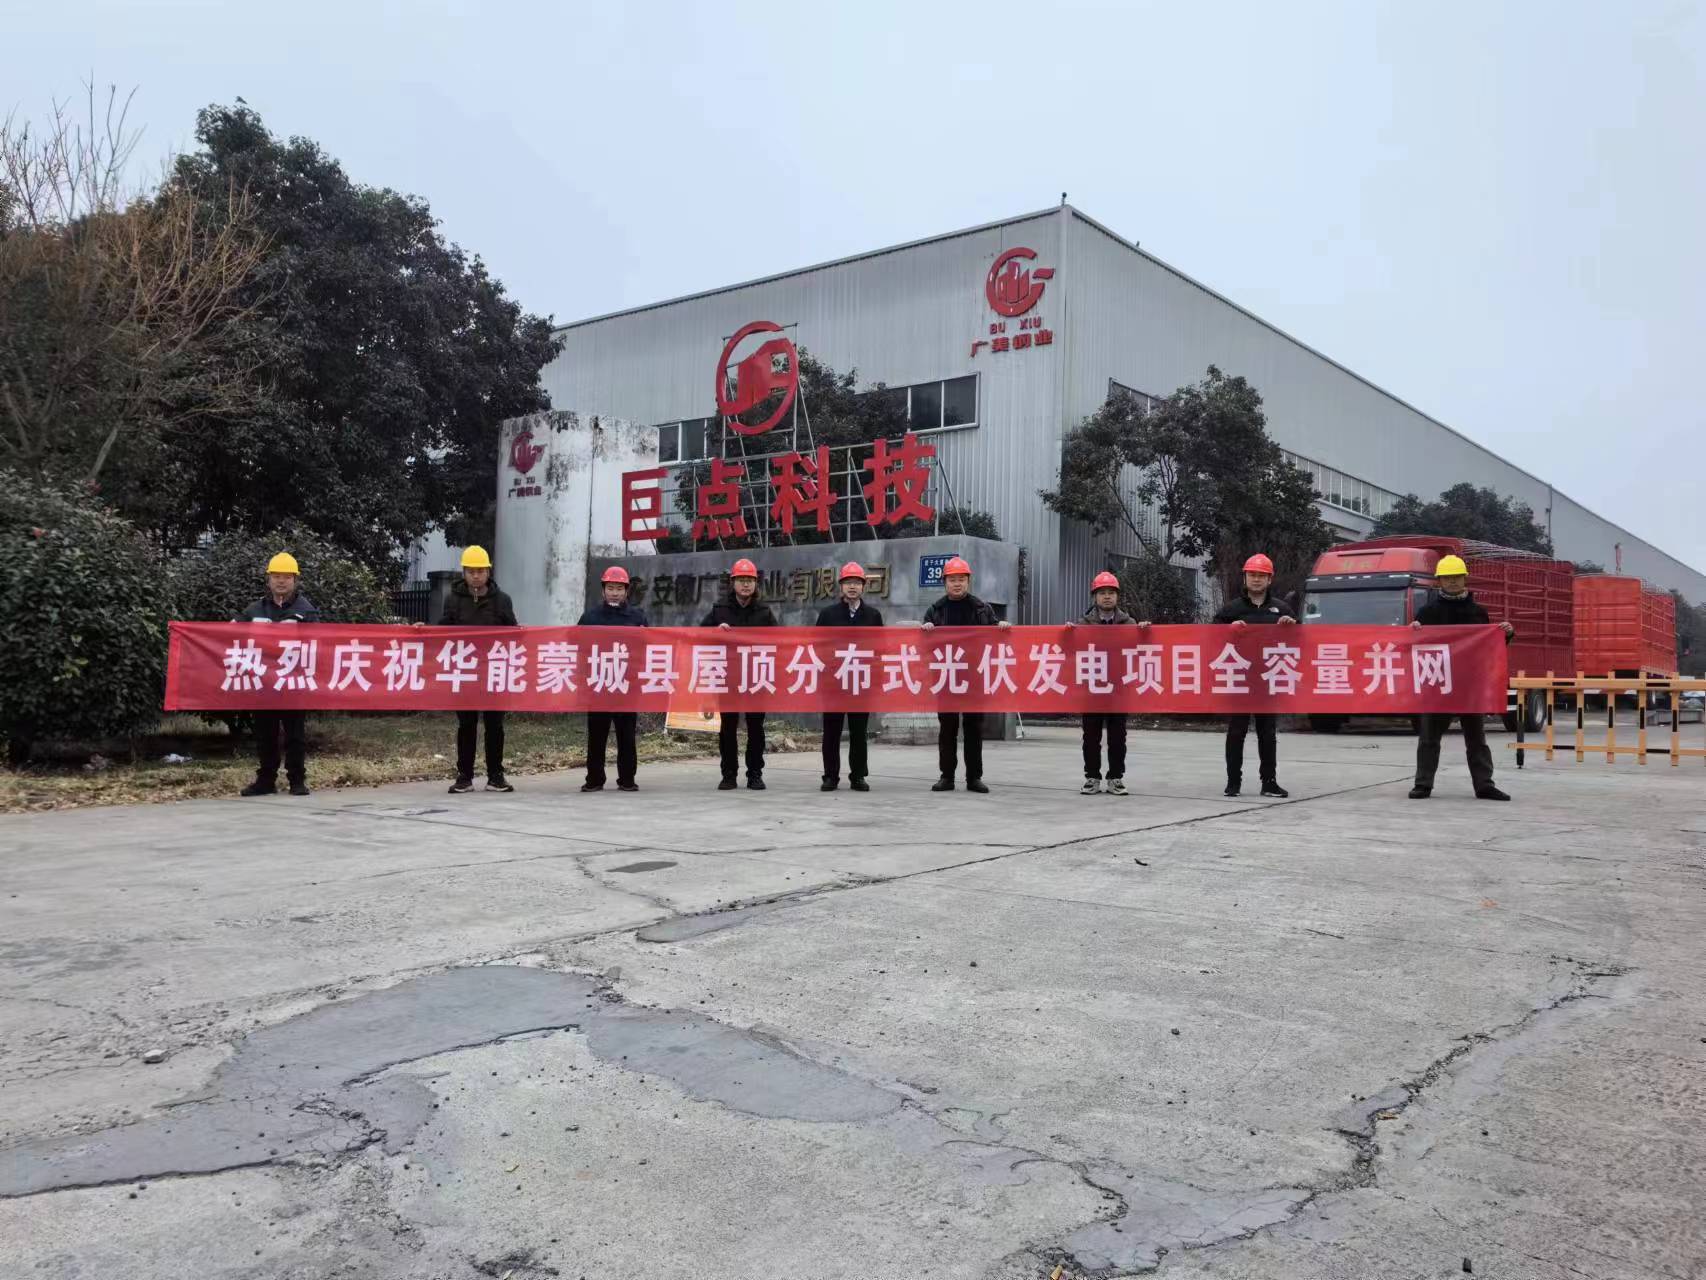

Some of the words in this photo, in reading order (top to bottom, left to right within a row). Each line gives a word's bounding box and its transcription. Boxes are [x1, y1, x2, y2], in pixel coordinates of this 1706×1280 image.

[622, 434, 936, 541] 巨点科技
[220, 639, 1454, 696] 热烈庆祝华能蒙城县屋顶分布式光伏发电项目全容量并网
